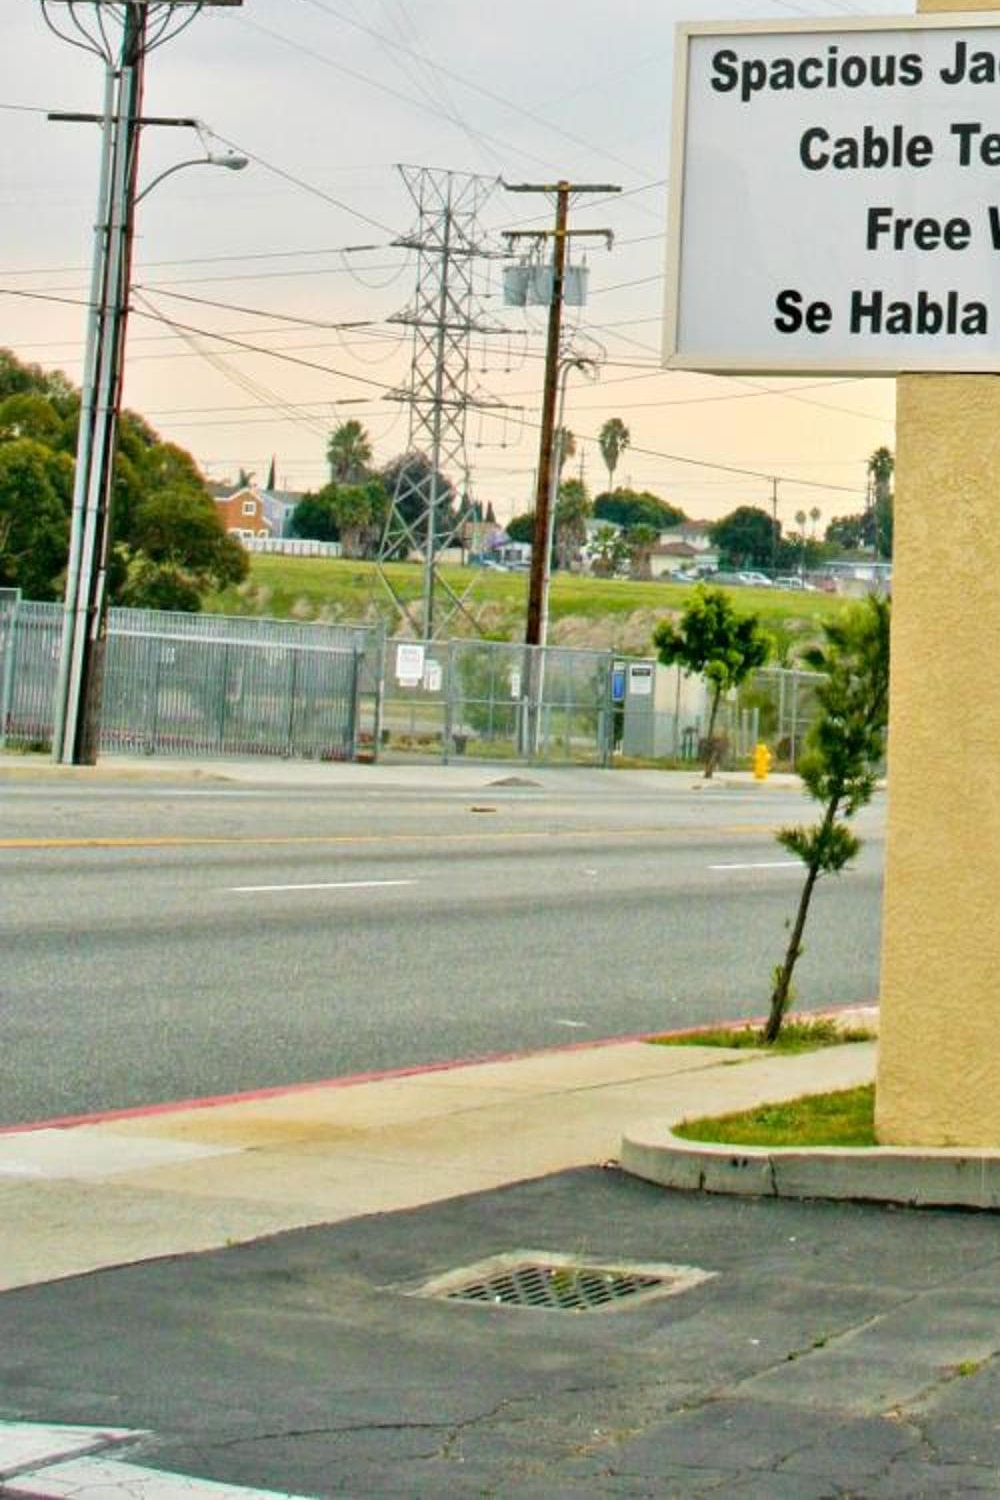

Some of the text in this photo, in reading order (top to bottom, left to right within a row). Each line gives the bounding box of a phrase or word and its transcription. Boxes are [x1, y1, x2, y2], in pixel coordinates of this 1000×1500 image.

[710, 45, 923, 103] Spacious
[799, 125, 934, 171] Cable
[866, 207, 971, 251] Free
[774, 289, 833, 335] Se
[849, 290, 988, 336] Habla
